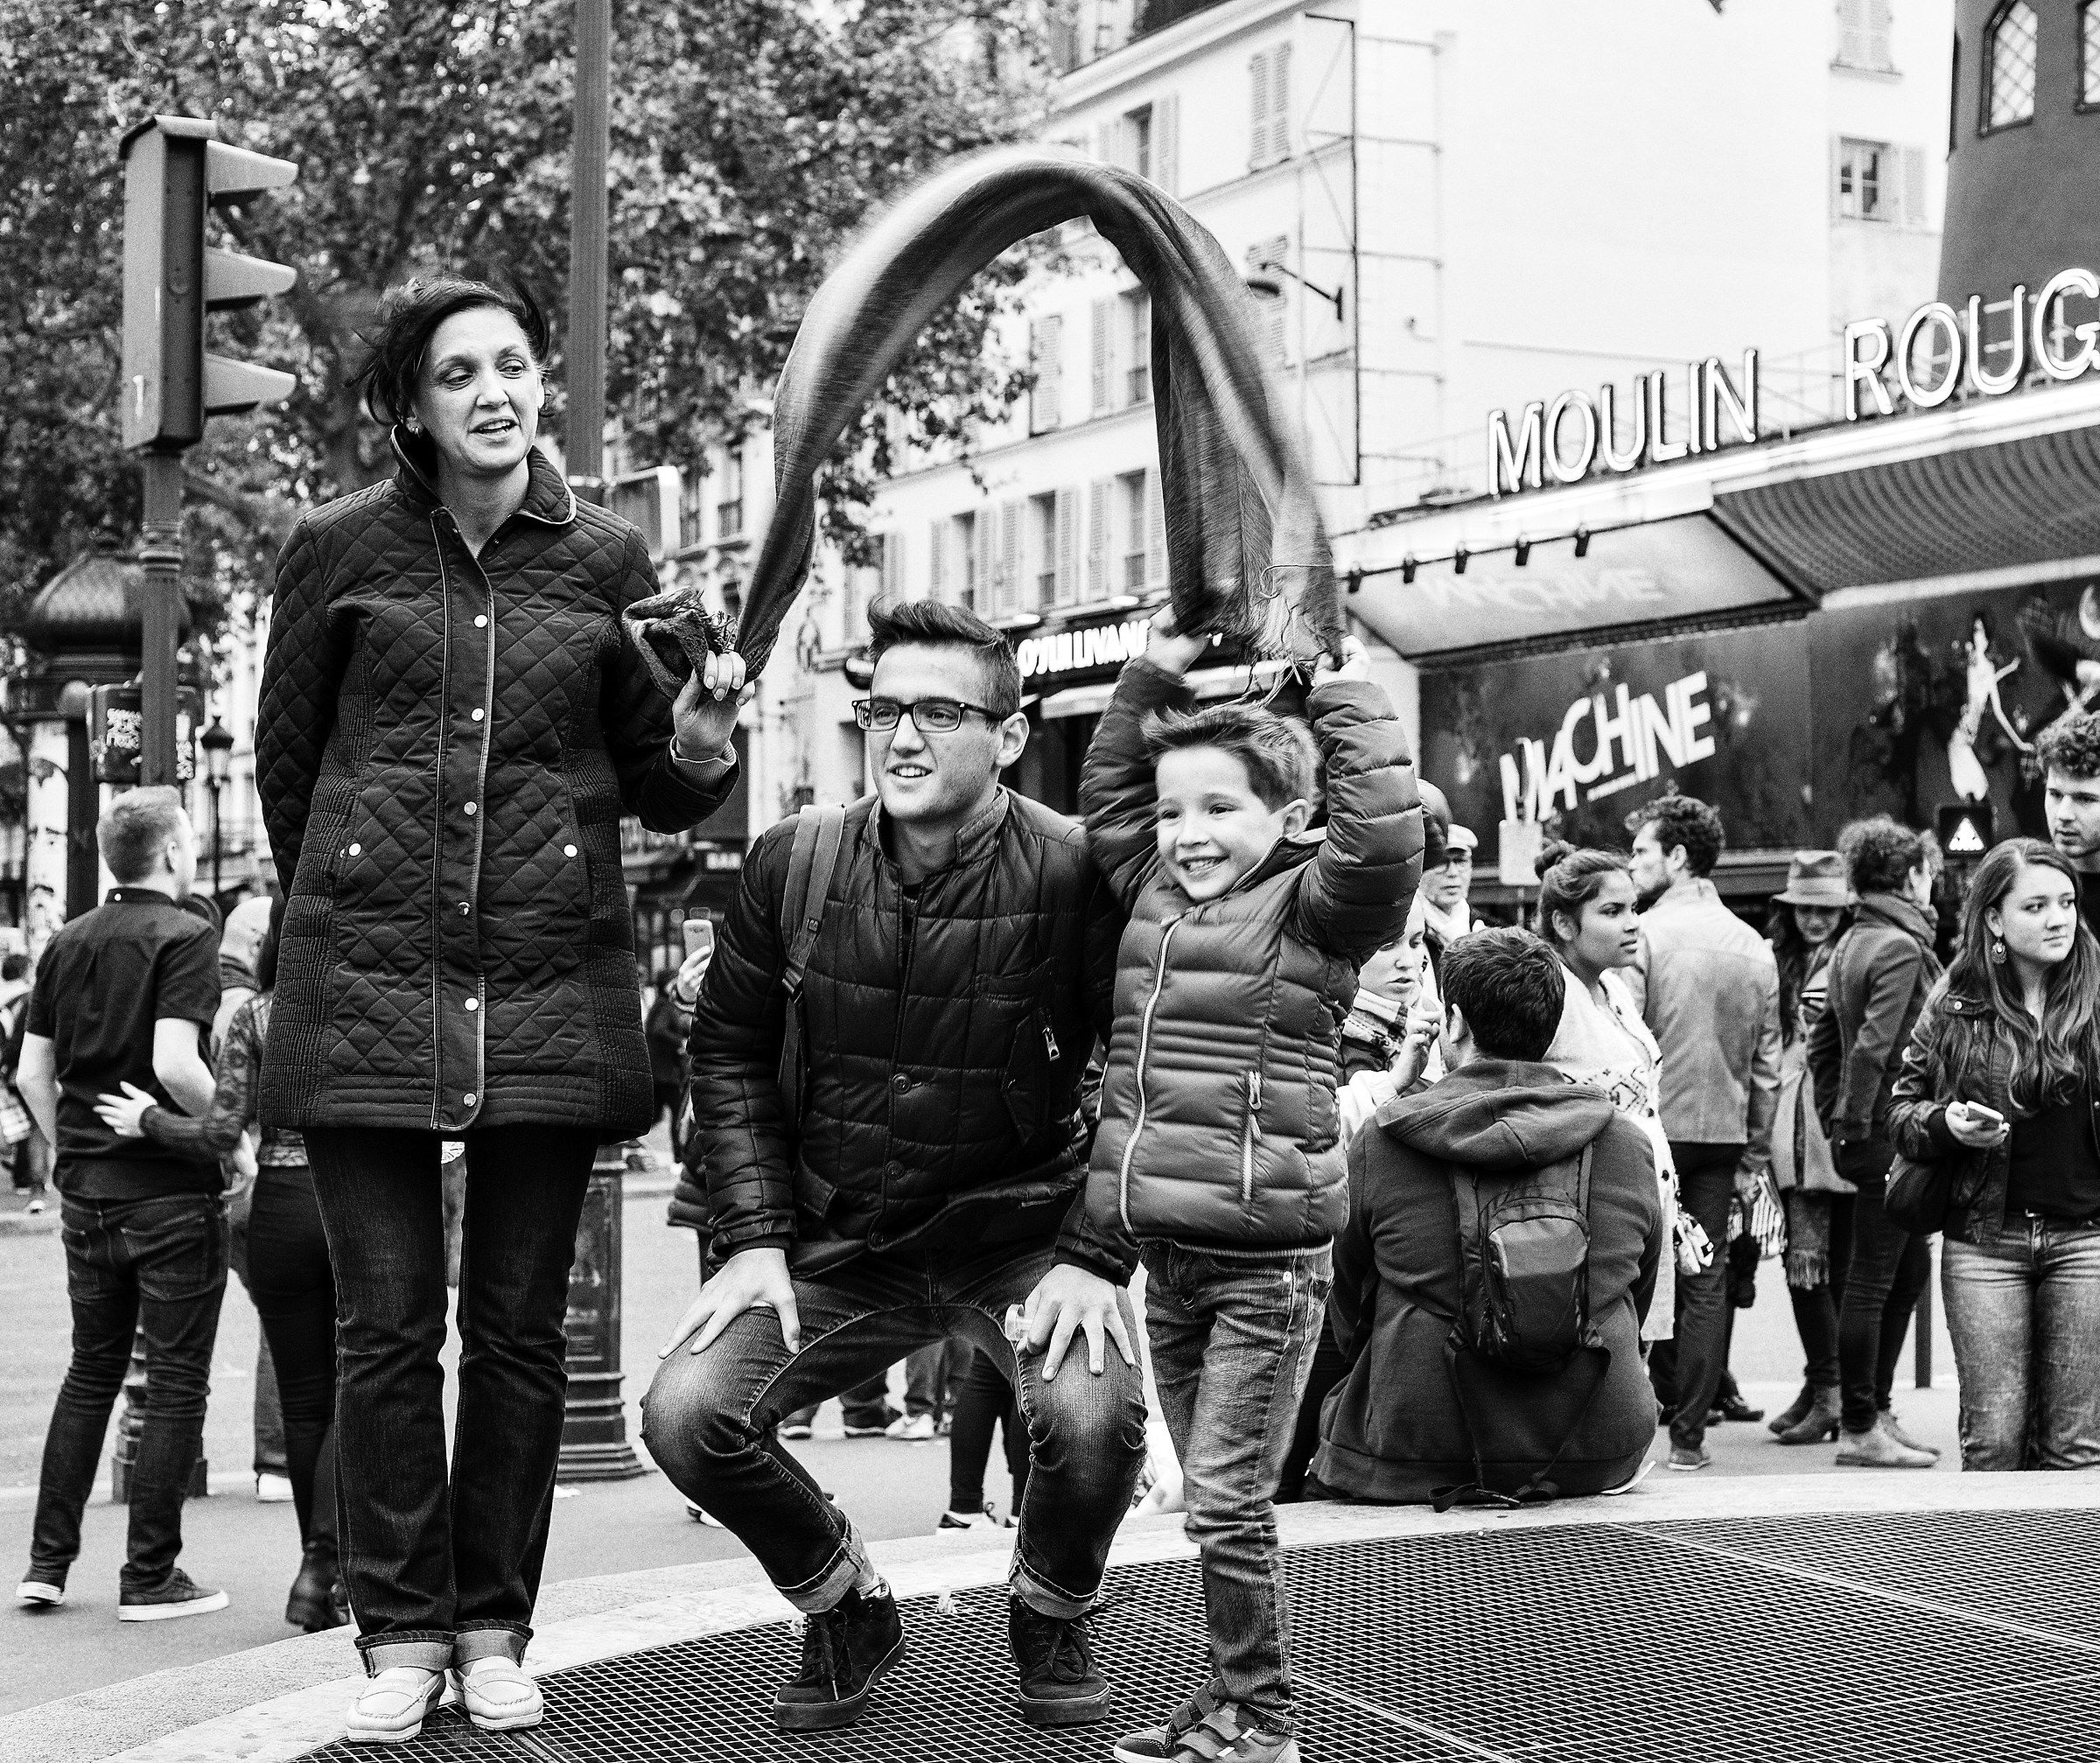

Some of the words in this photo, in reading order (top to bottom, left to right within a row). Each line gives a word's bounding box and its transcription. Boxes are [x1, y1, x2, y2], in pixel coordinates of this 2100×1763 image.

[1488, 347, 1756, 496] MOULIN
[1844, 268, 2100, 421] ROUG
[1499, 670, 1716, 821] MACHINE
